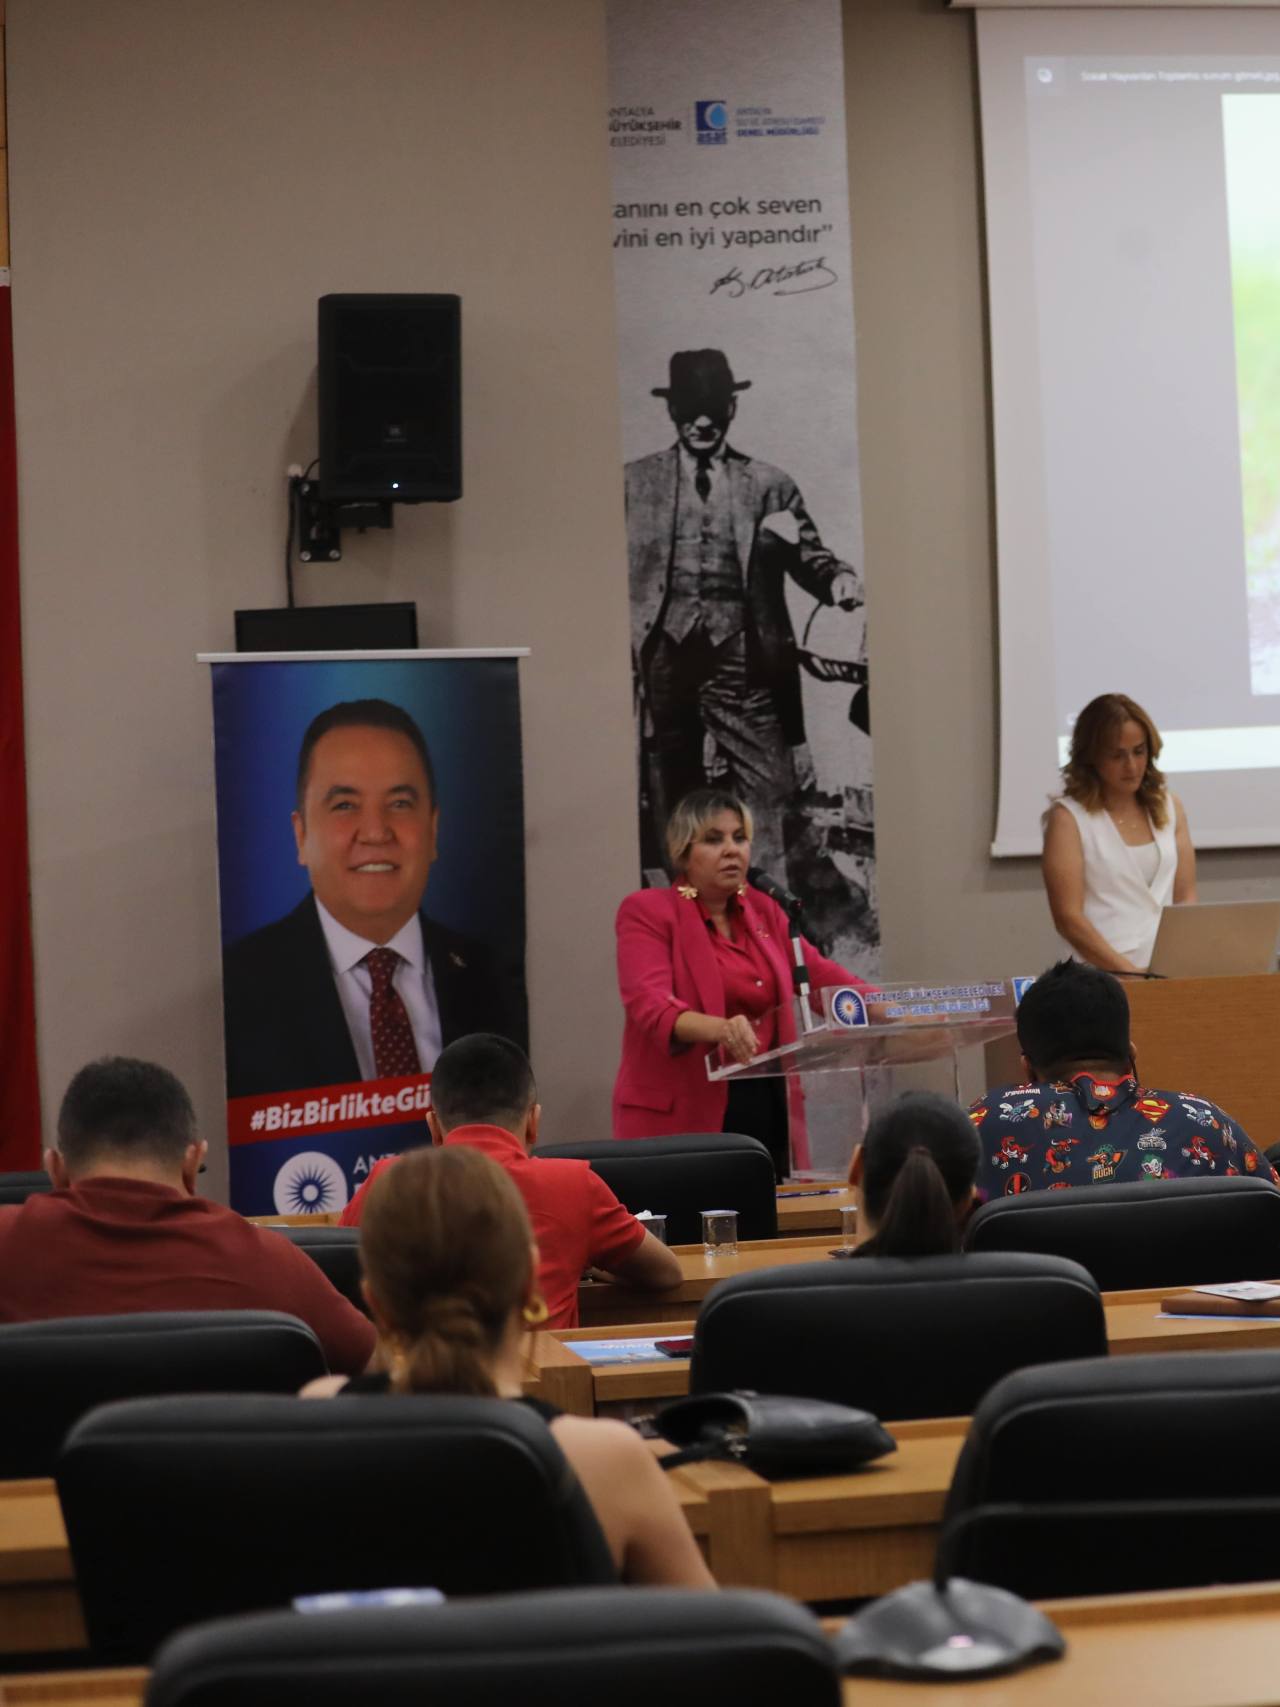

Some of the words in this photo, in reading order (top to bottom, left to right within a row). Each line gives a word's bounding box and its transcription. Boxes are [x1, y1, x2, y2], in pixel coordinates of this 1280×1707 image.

[675, 202, 703, 217] en
[709, 197, 750, 219] çok
[757, 199, 822, 215] seven
[655, 232, 683, 248] en
[690, 227, 715, 250] iyi
[250, 1083, 432, 1132] #BizBirlikteGü
